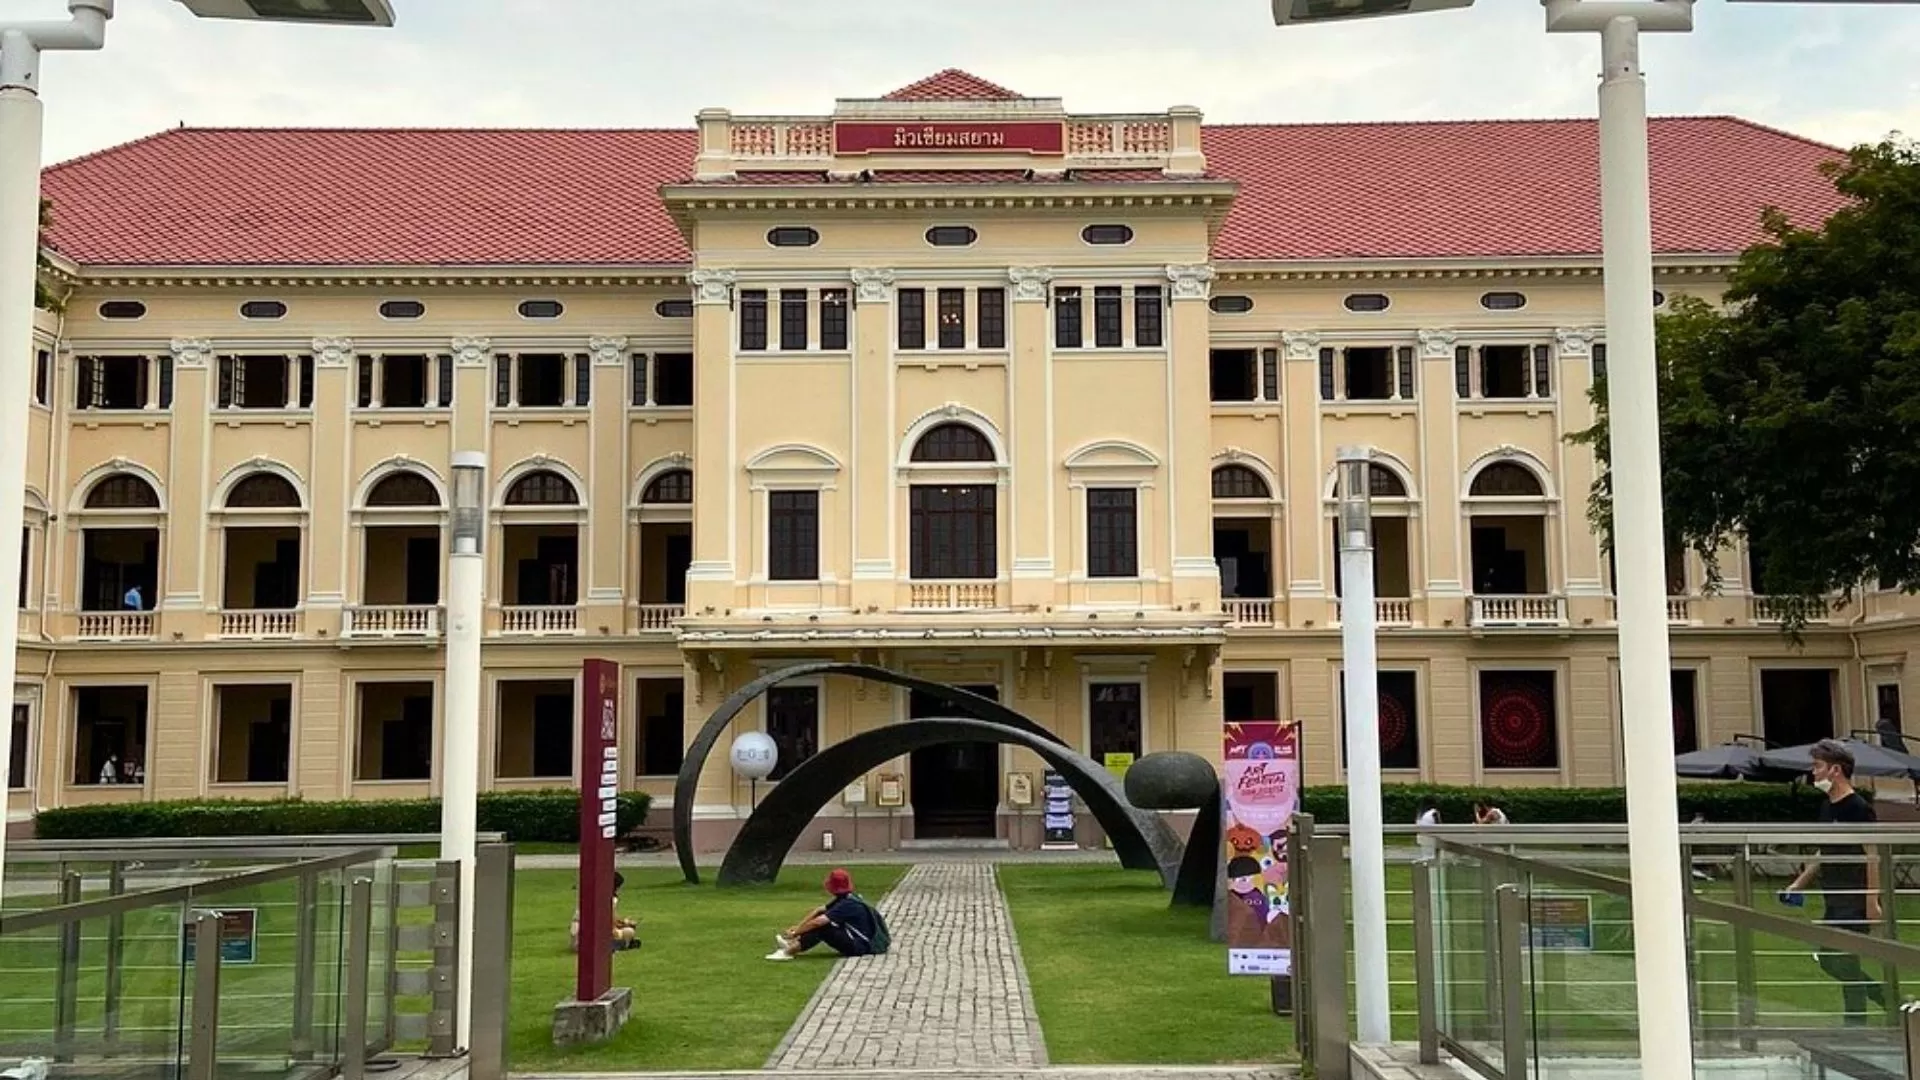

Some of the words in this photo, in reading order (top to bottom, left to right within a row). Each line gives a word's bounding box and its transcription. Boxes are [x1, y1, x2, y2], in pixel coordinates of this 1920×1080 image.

[894, 126, 1004, 146] มิวเซียมสยาม
[1244, 762, 1268, 776] ART
